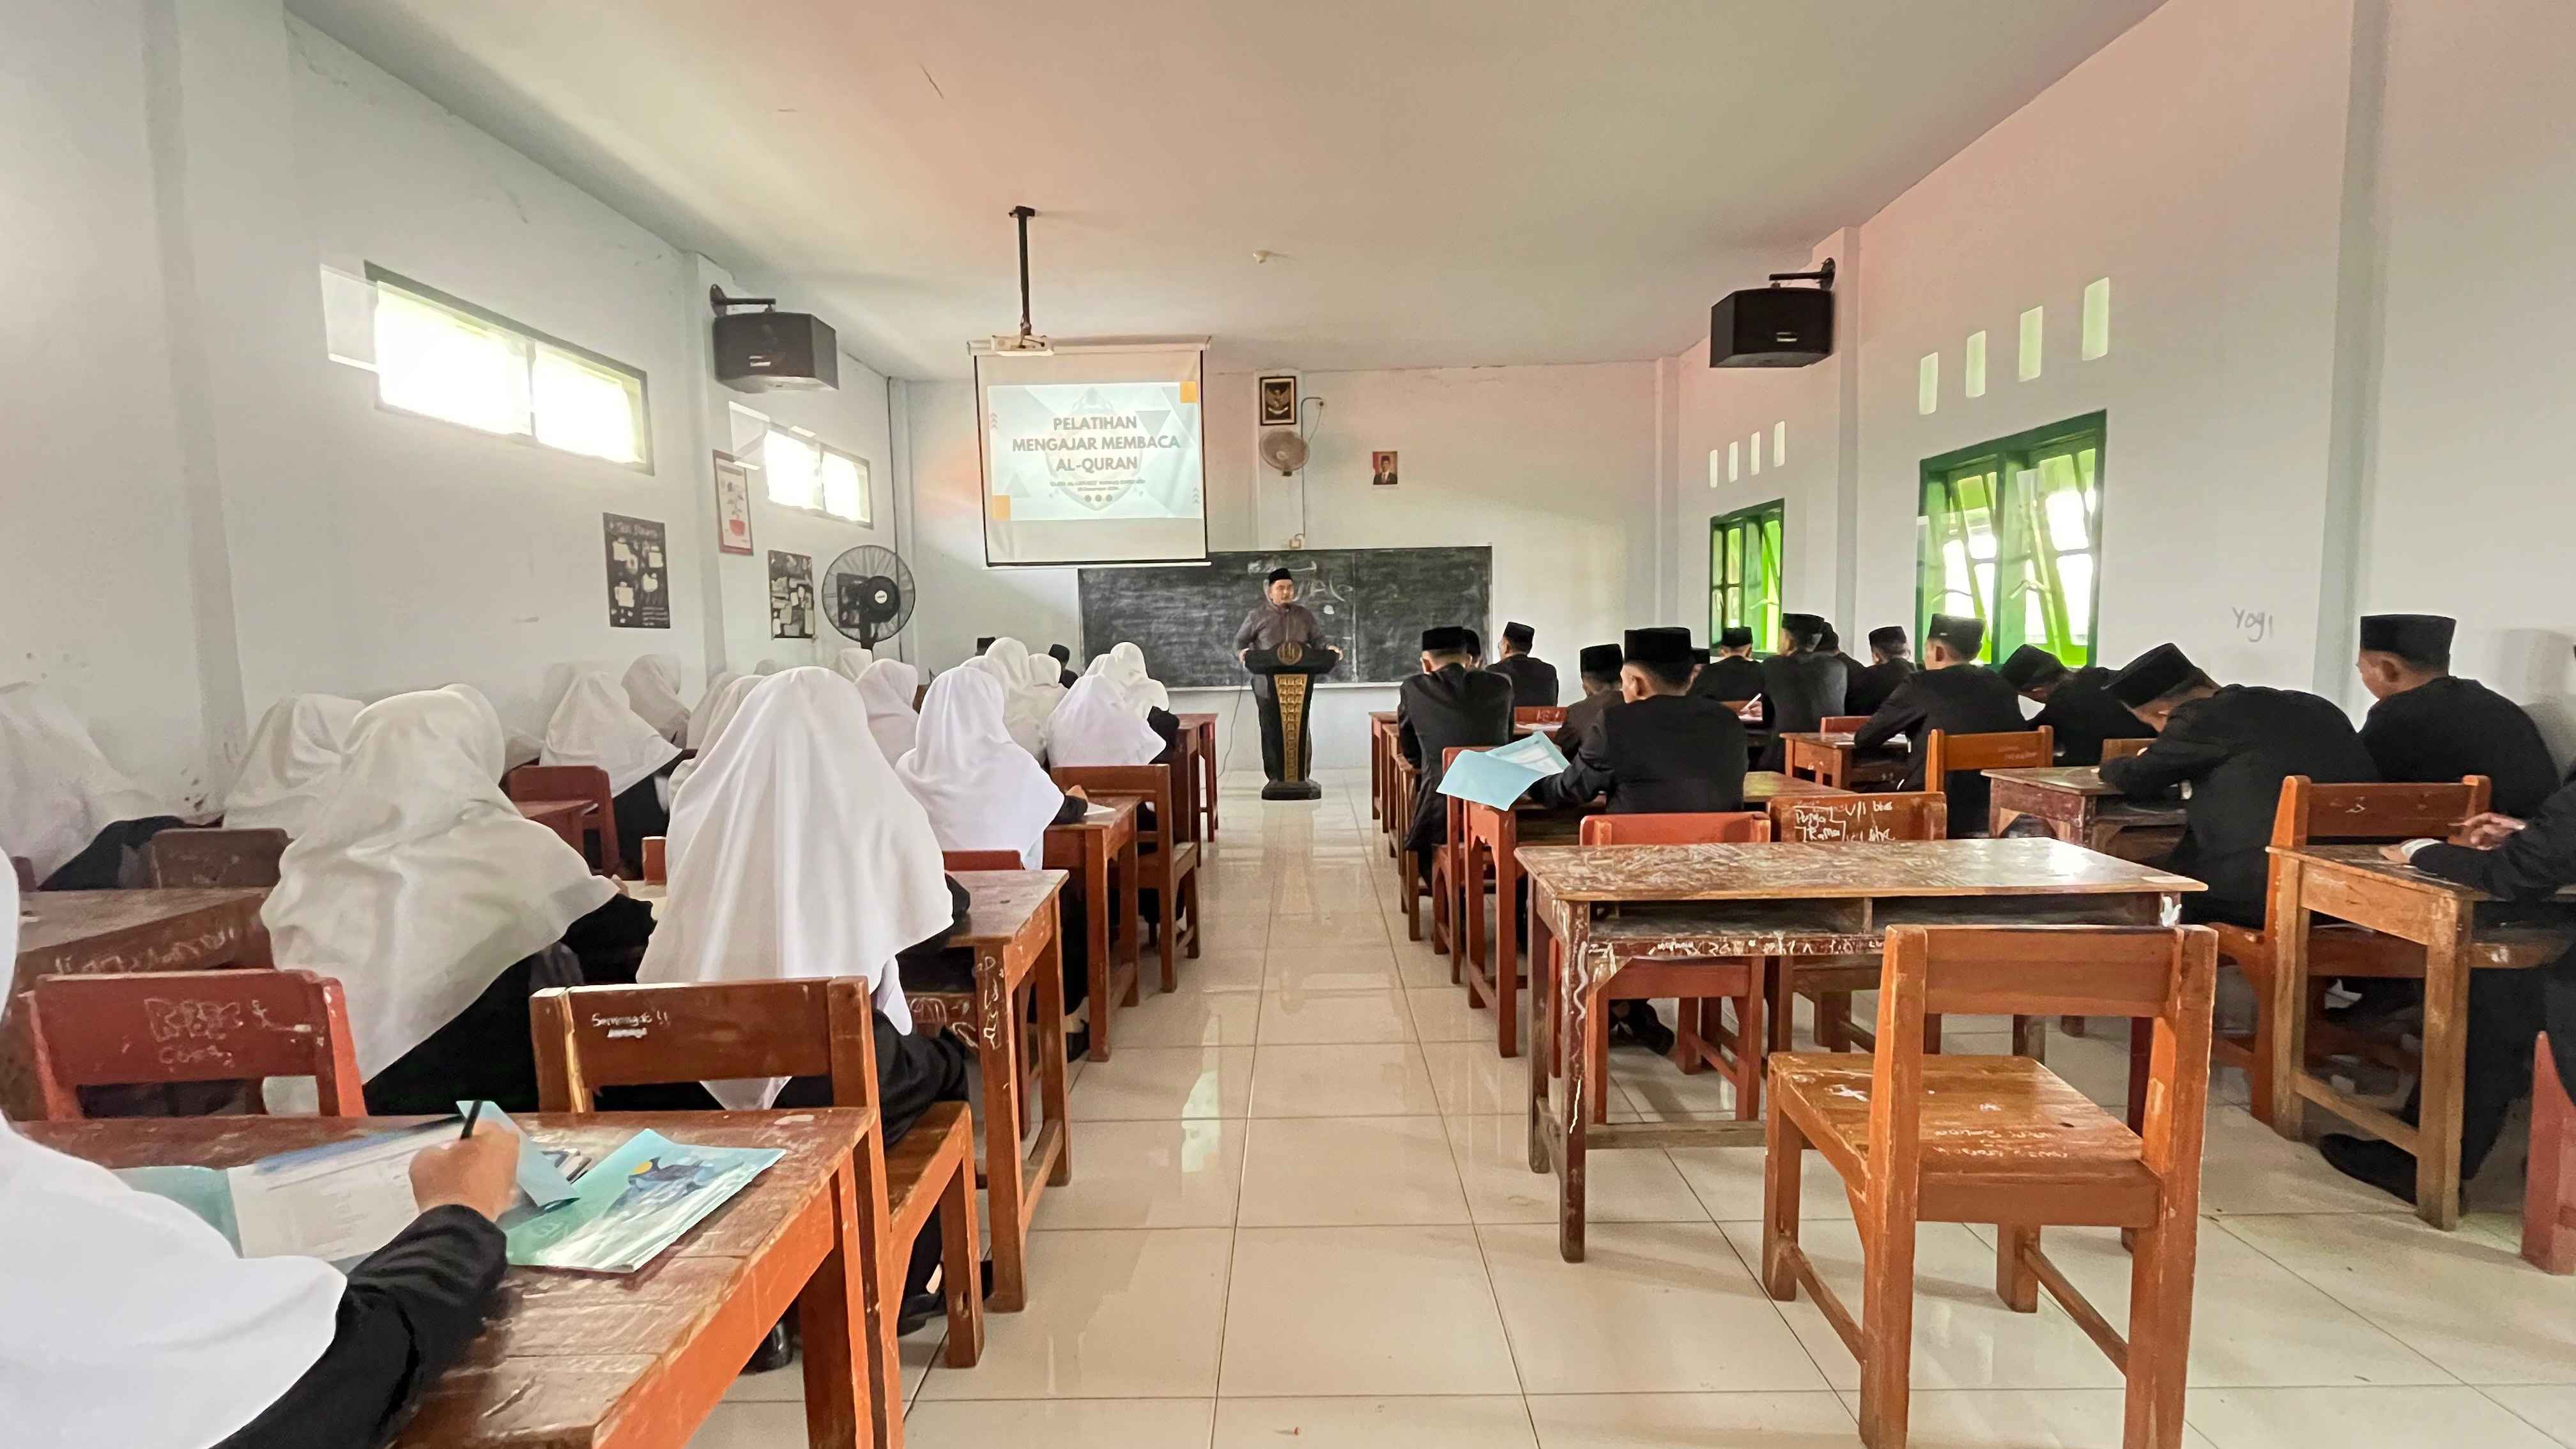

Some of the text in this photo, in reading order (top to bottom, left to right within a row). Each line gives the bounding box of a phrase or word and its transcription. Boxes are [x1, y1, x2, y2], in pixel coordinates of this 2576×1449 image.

[1053, 416, 1137, 431] PELATIHAN
[1012, 435, 1181, 452] MENGAJAR MEMBACA
[1055, 456, 1138, 473] AL-QURAN
